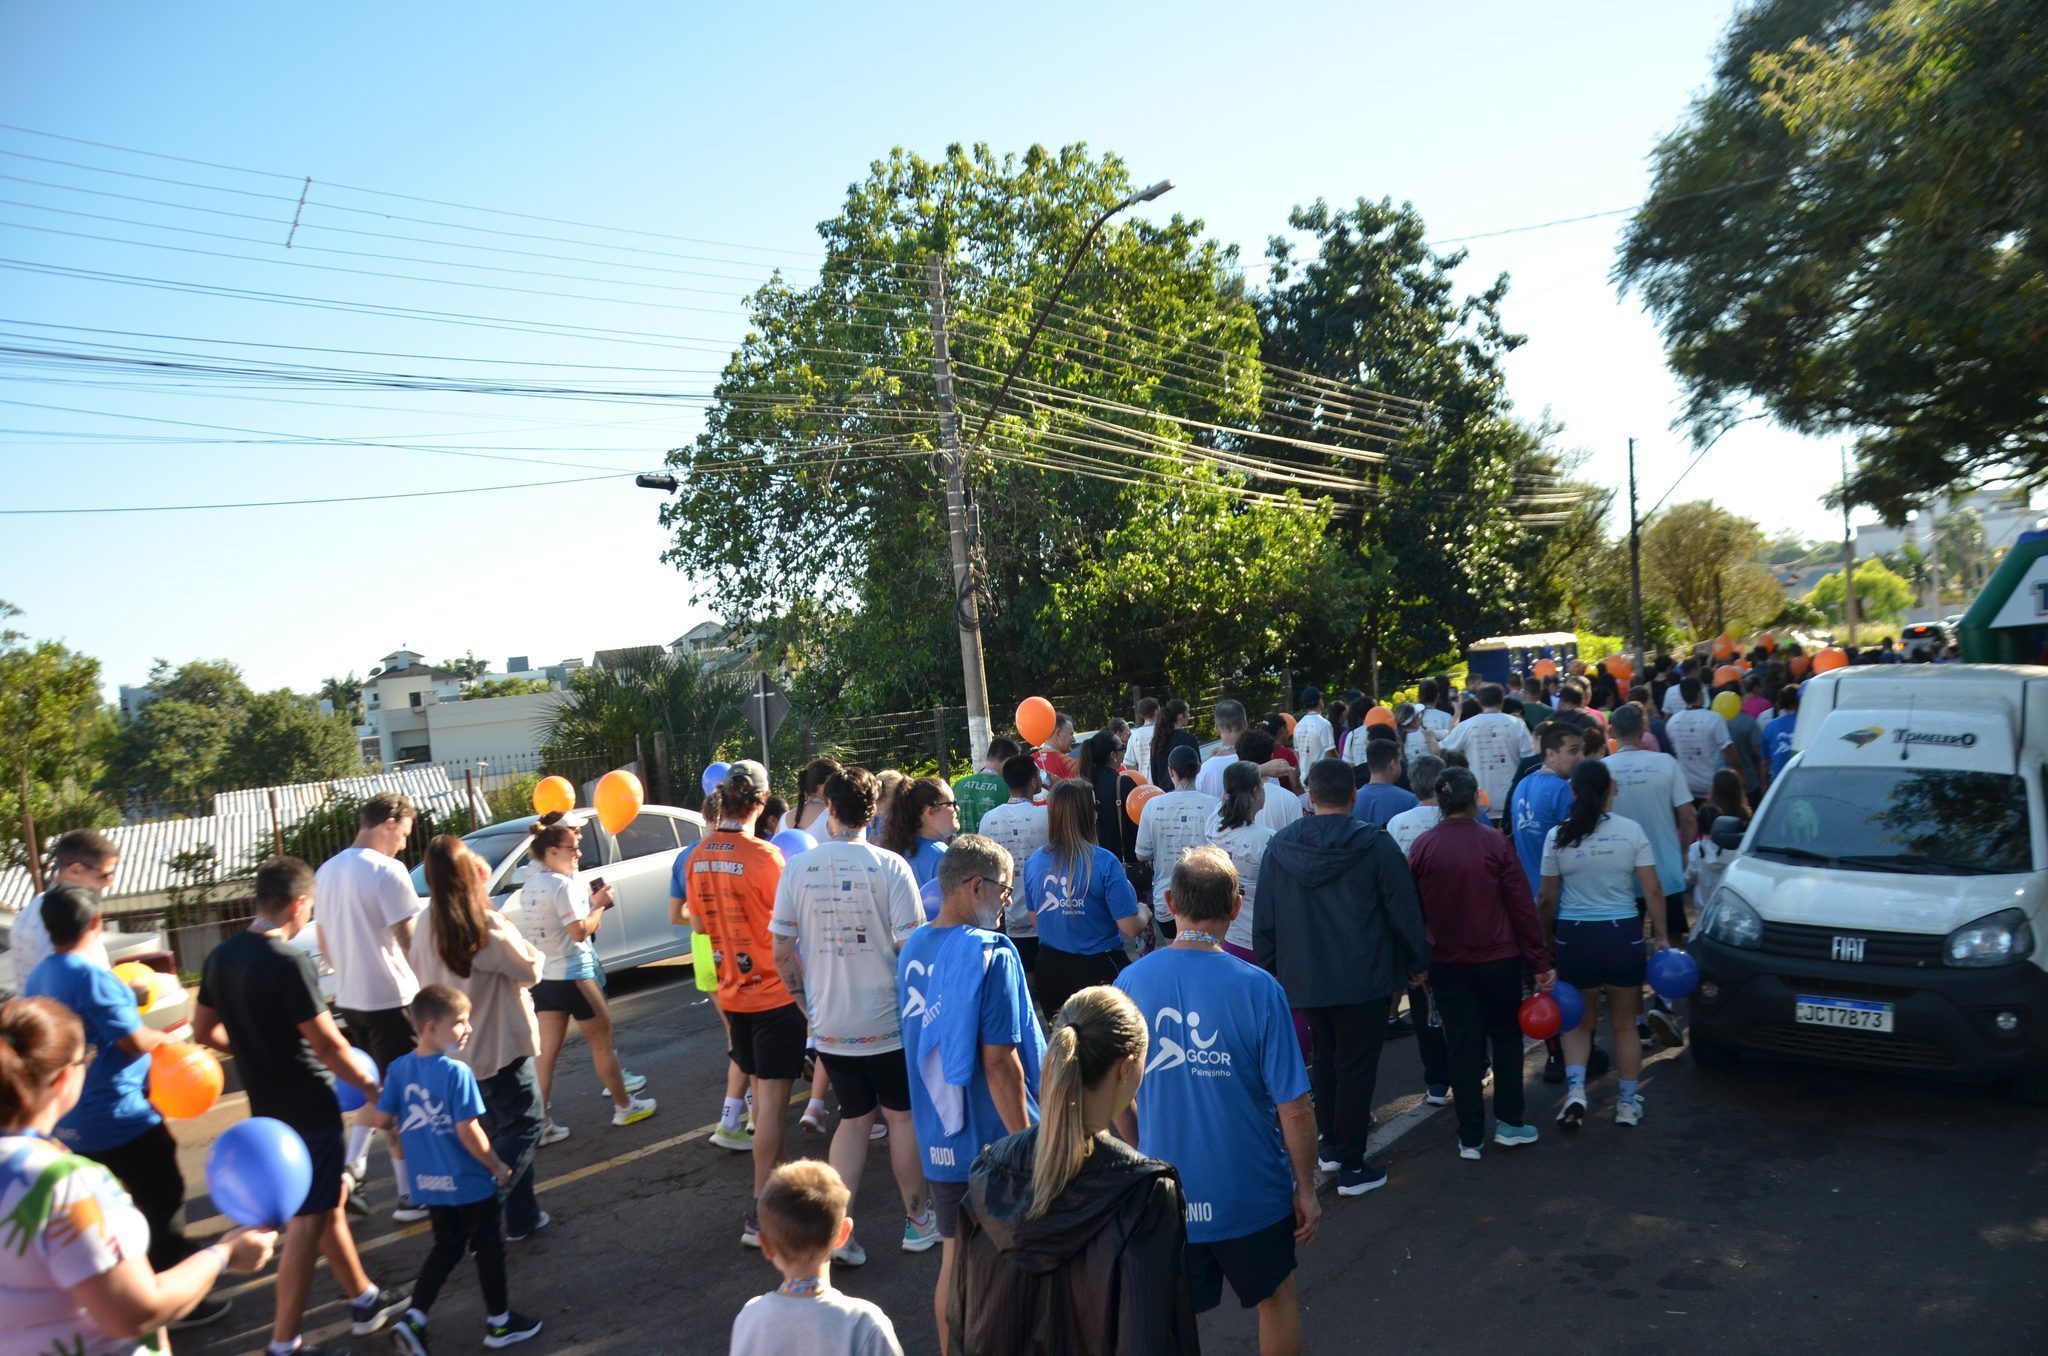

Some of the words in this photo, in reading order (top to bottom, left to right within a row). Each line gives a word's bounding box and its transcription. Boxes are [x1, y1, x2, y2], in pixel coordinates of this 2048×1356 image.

[963, 780, 998, 792] ATLETA
[705, 842, 736, 852] ATLETA
[711, 860, 744, 876] HERMES
[1831, 936, 1868, 962] FIAT
[1804, 1005, 1883, 1028] JCT7B73
[1186, 1048, 1231, 1066] GCOR
[1191, 1067, 1231, 1078] Palmitinho
[929, 1146, 956, 1167] RUDI
